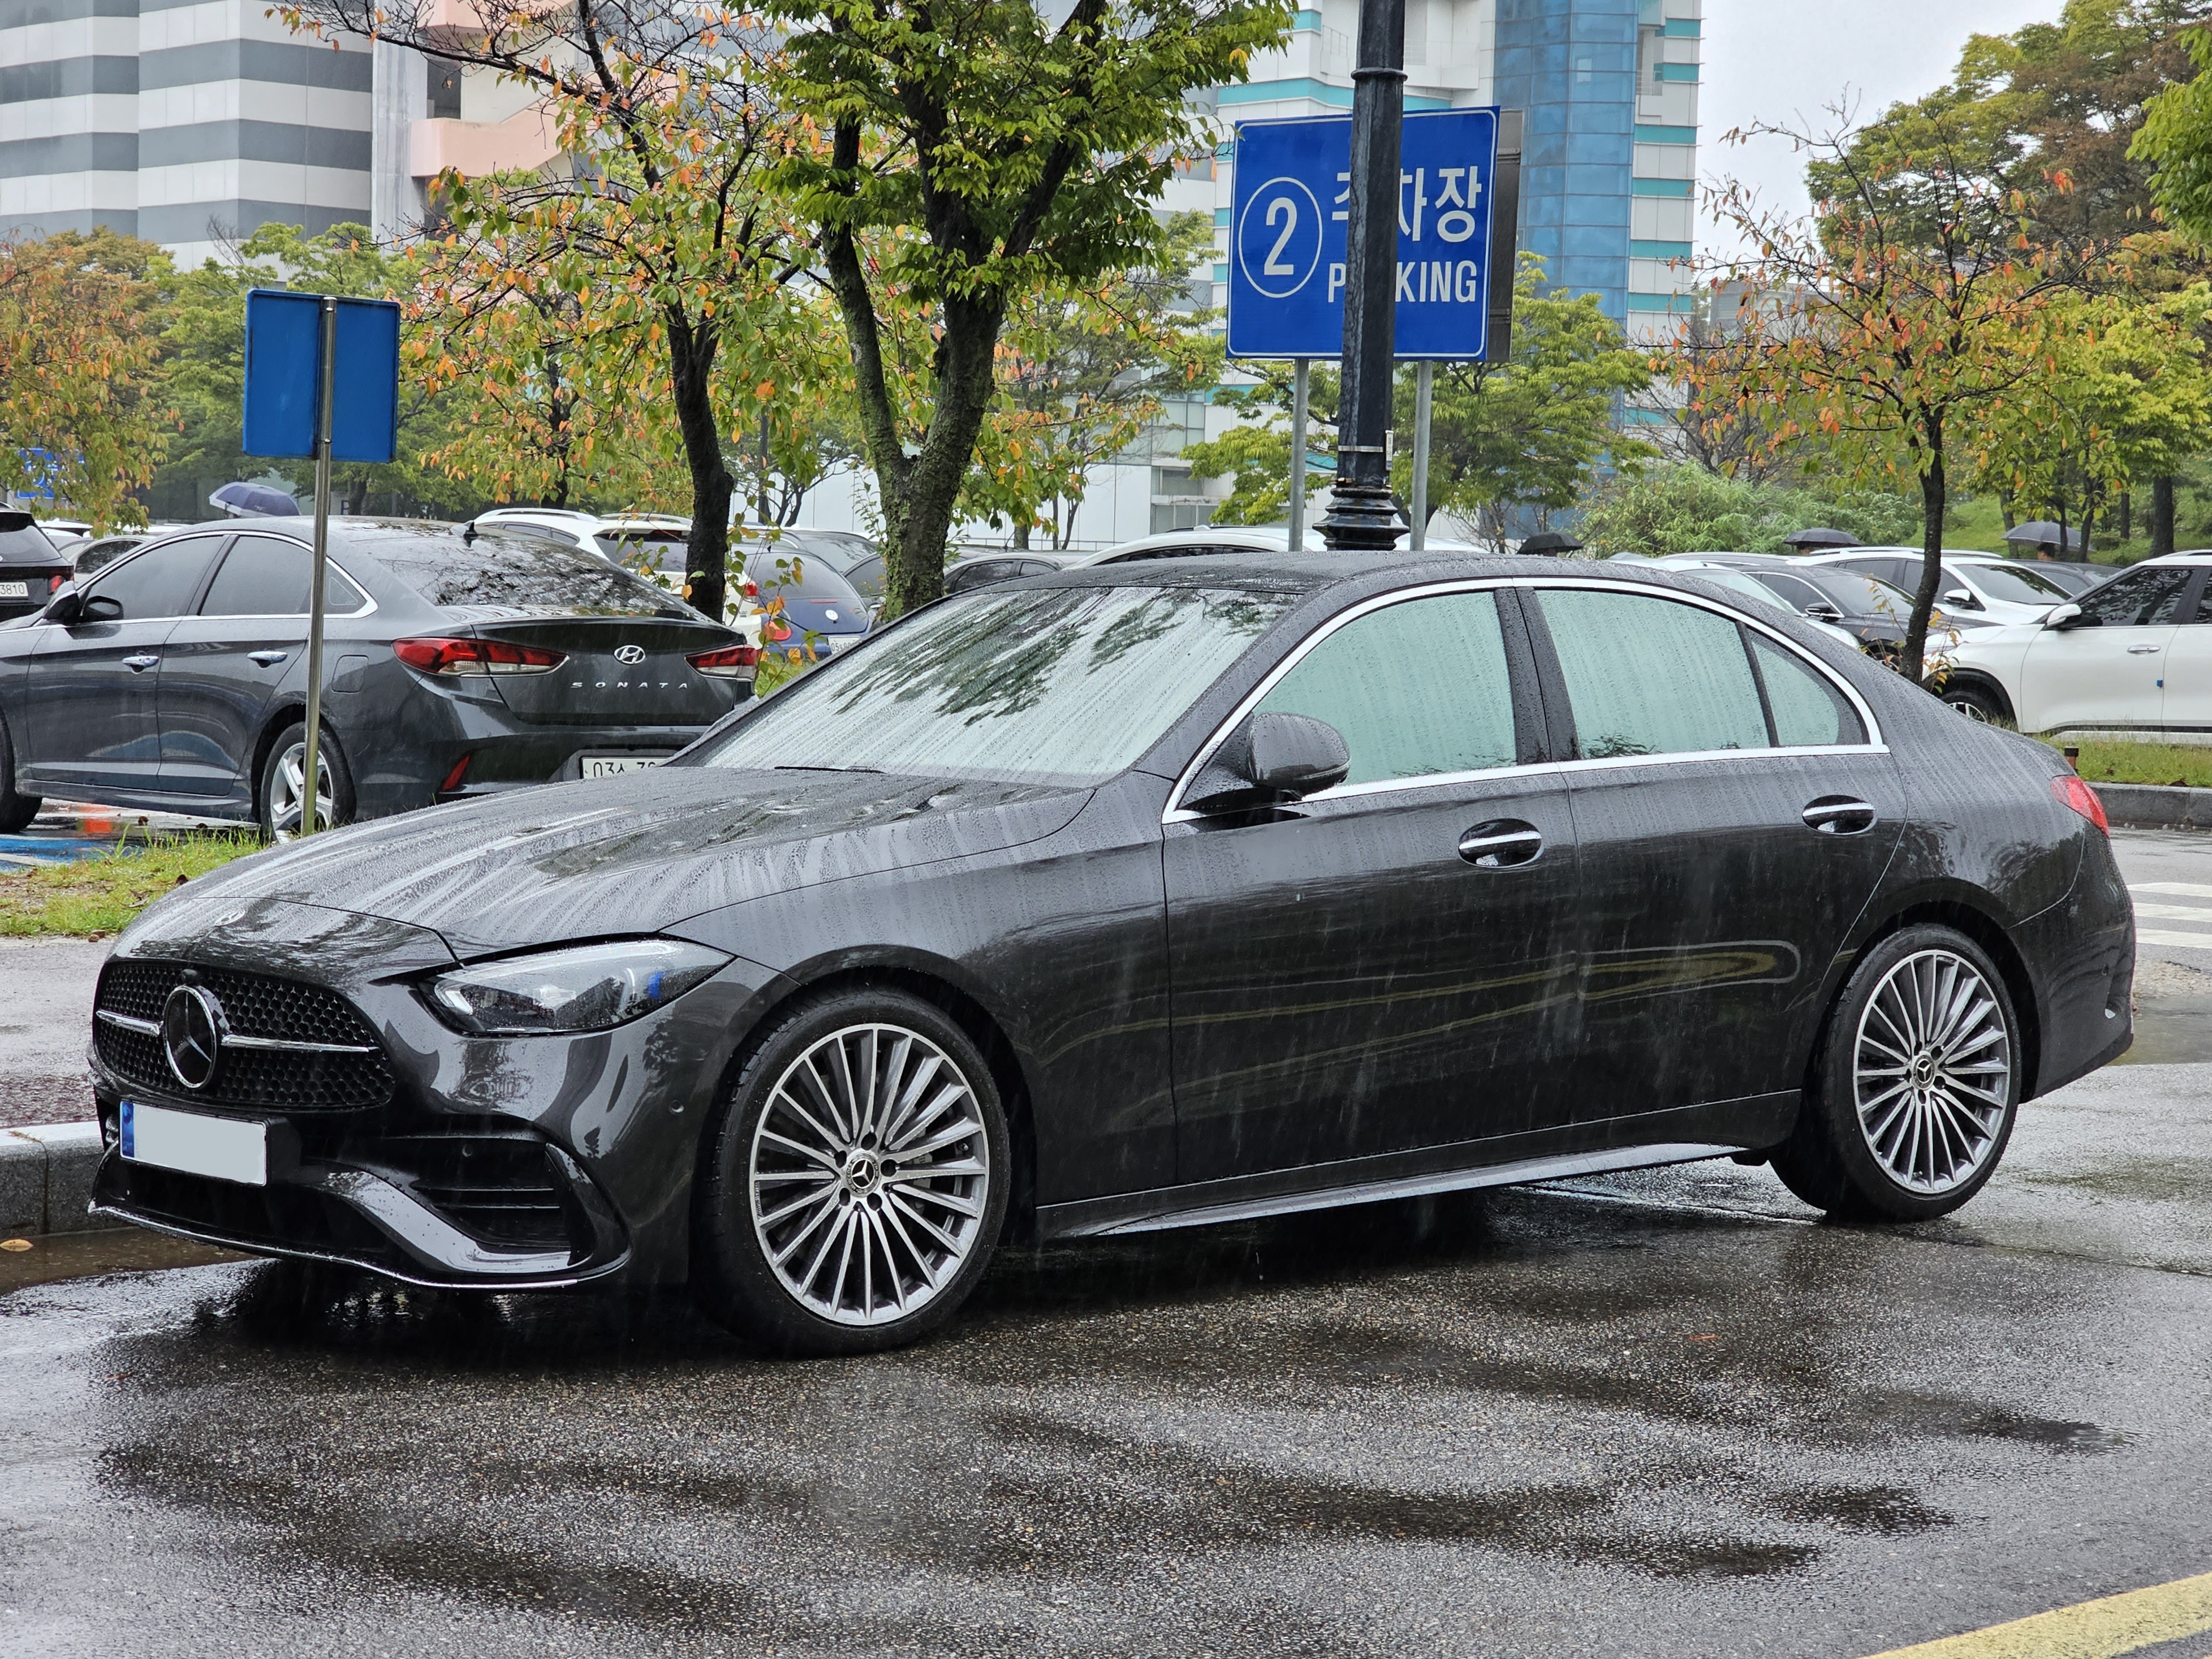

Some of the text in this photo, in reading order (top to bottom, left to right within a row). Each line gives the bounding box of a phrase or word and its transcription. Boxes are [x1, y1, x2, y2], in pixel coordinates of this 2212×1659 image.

[1264, 197, 1297, 275] 2
[1327, 260, 1477, 303] PKING
[0, 584, 25, 594] 3810
